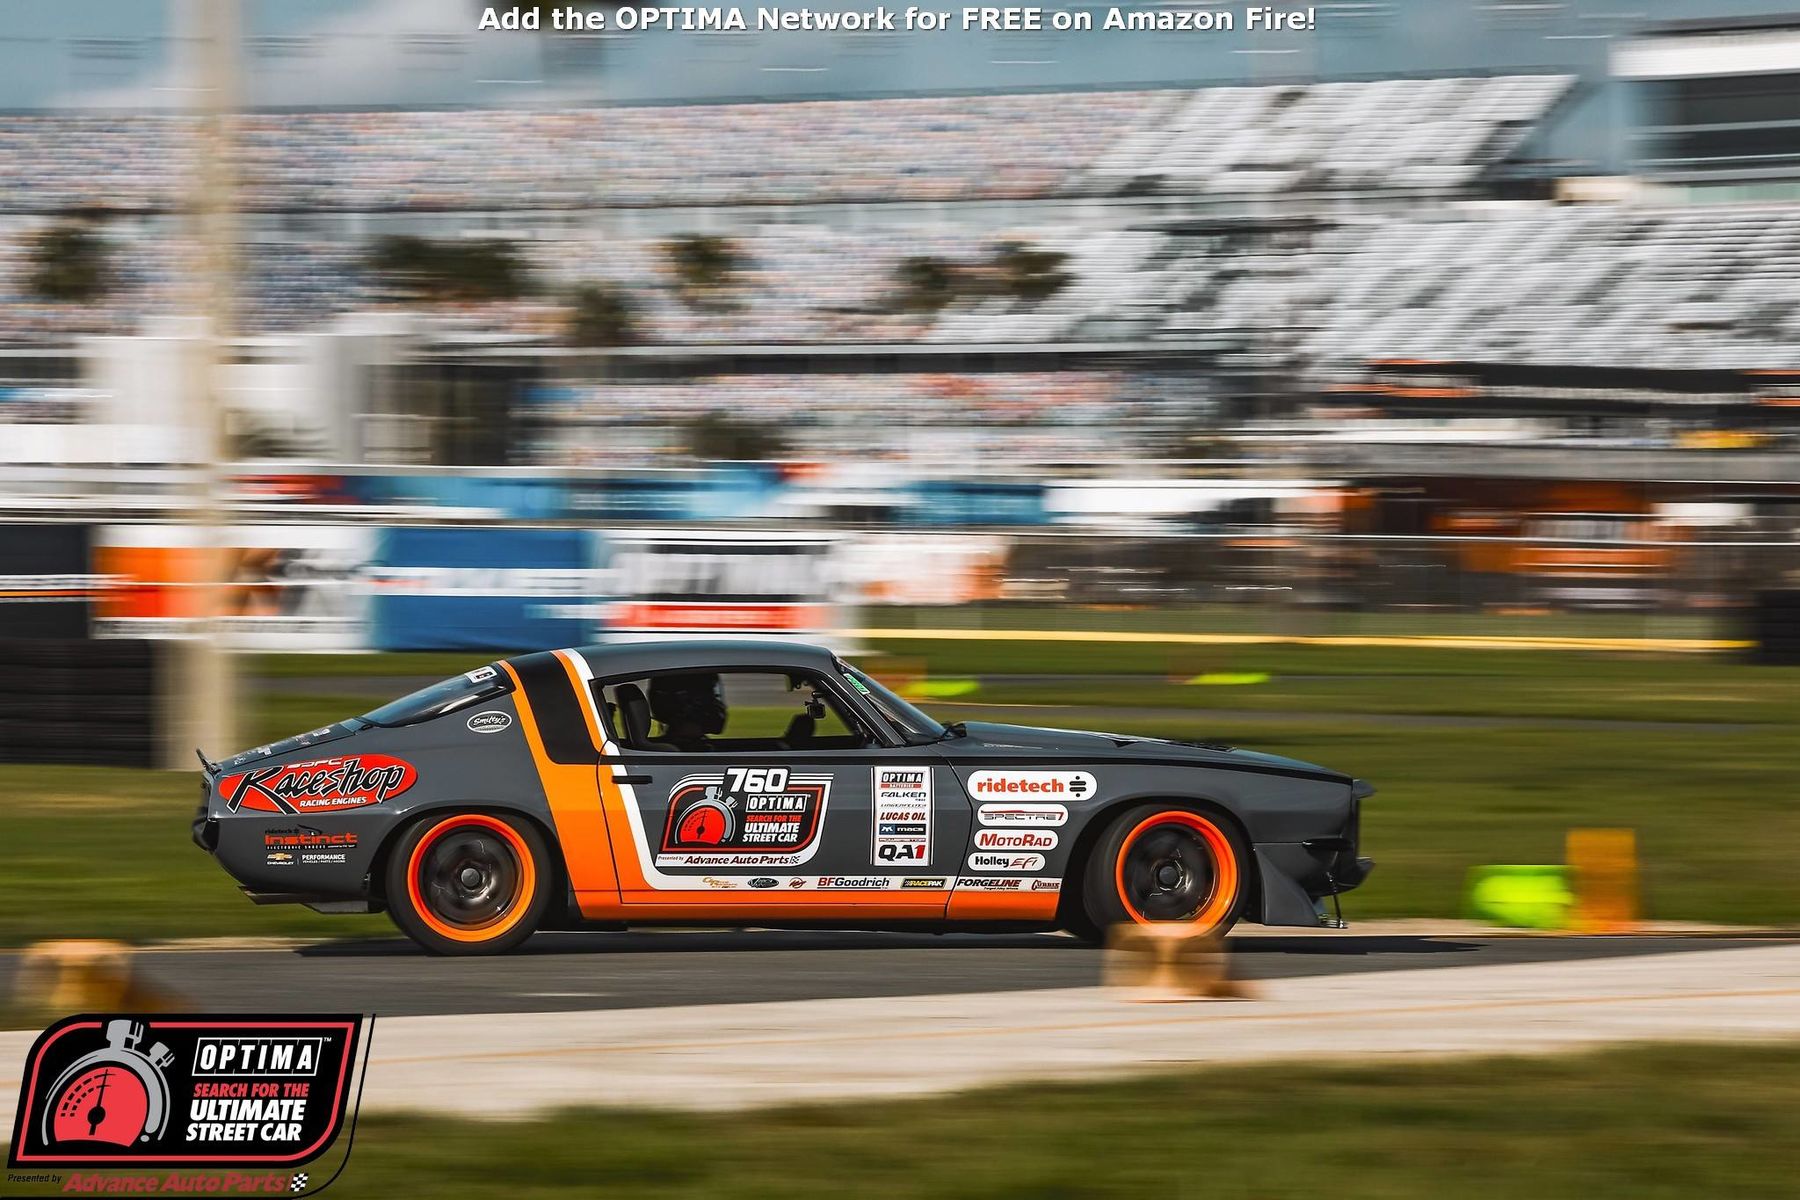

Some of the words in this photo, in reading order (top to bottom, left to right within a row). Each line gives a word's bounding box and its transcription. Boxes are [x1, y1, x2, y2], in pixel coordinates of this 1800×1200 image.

[726, 768, 789, 793] 760
[882, 773, 923, 782] OPTIMA
[226, 757, 405, 815] Raceshop
[977, 778, 1064, 793] ridetech
[299, 798, 331, 808] RACING
[331, 796, 367, 806] ENGINES
[749, 795, 804, 810] OPTIMA
[746, 815, 773, 823] SEARCH
[773, 815, 788, 823] FOR
[788, 815, 802, 823] THE
[880, 812, 910, 821] LUCAS
[911, 812, 926, 821] OIL
[744, 822, 800, 833] ULTIMATE
[264, 832, 359, 846] instinct
[742, 833, 778, 842] STREET
[778, 833, 798, 842] CAR
[878, 844, 926, 861] QA1
[684, 855, 730, 865] Advance
[730, 855, 759, 865] Auto
[759, 855, 789, 865] Parts
[975, 856, 1010, 868] Holley
[817, 877, 890, 888] BFGoodrich
[957, 879, 1022, 888] FORGELINE
